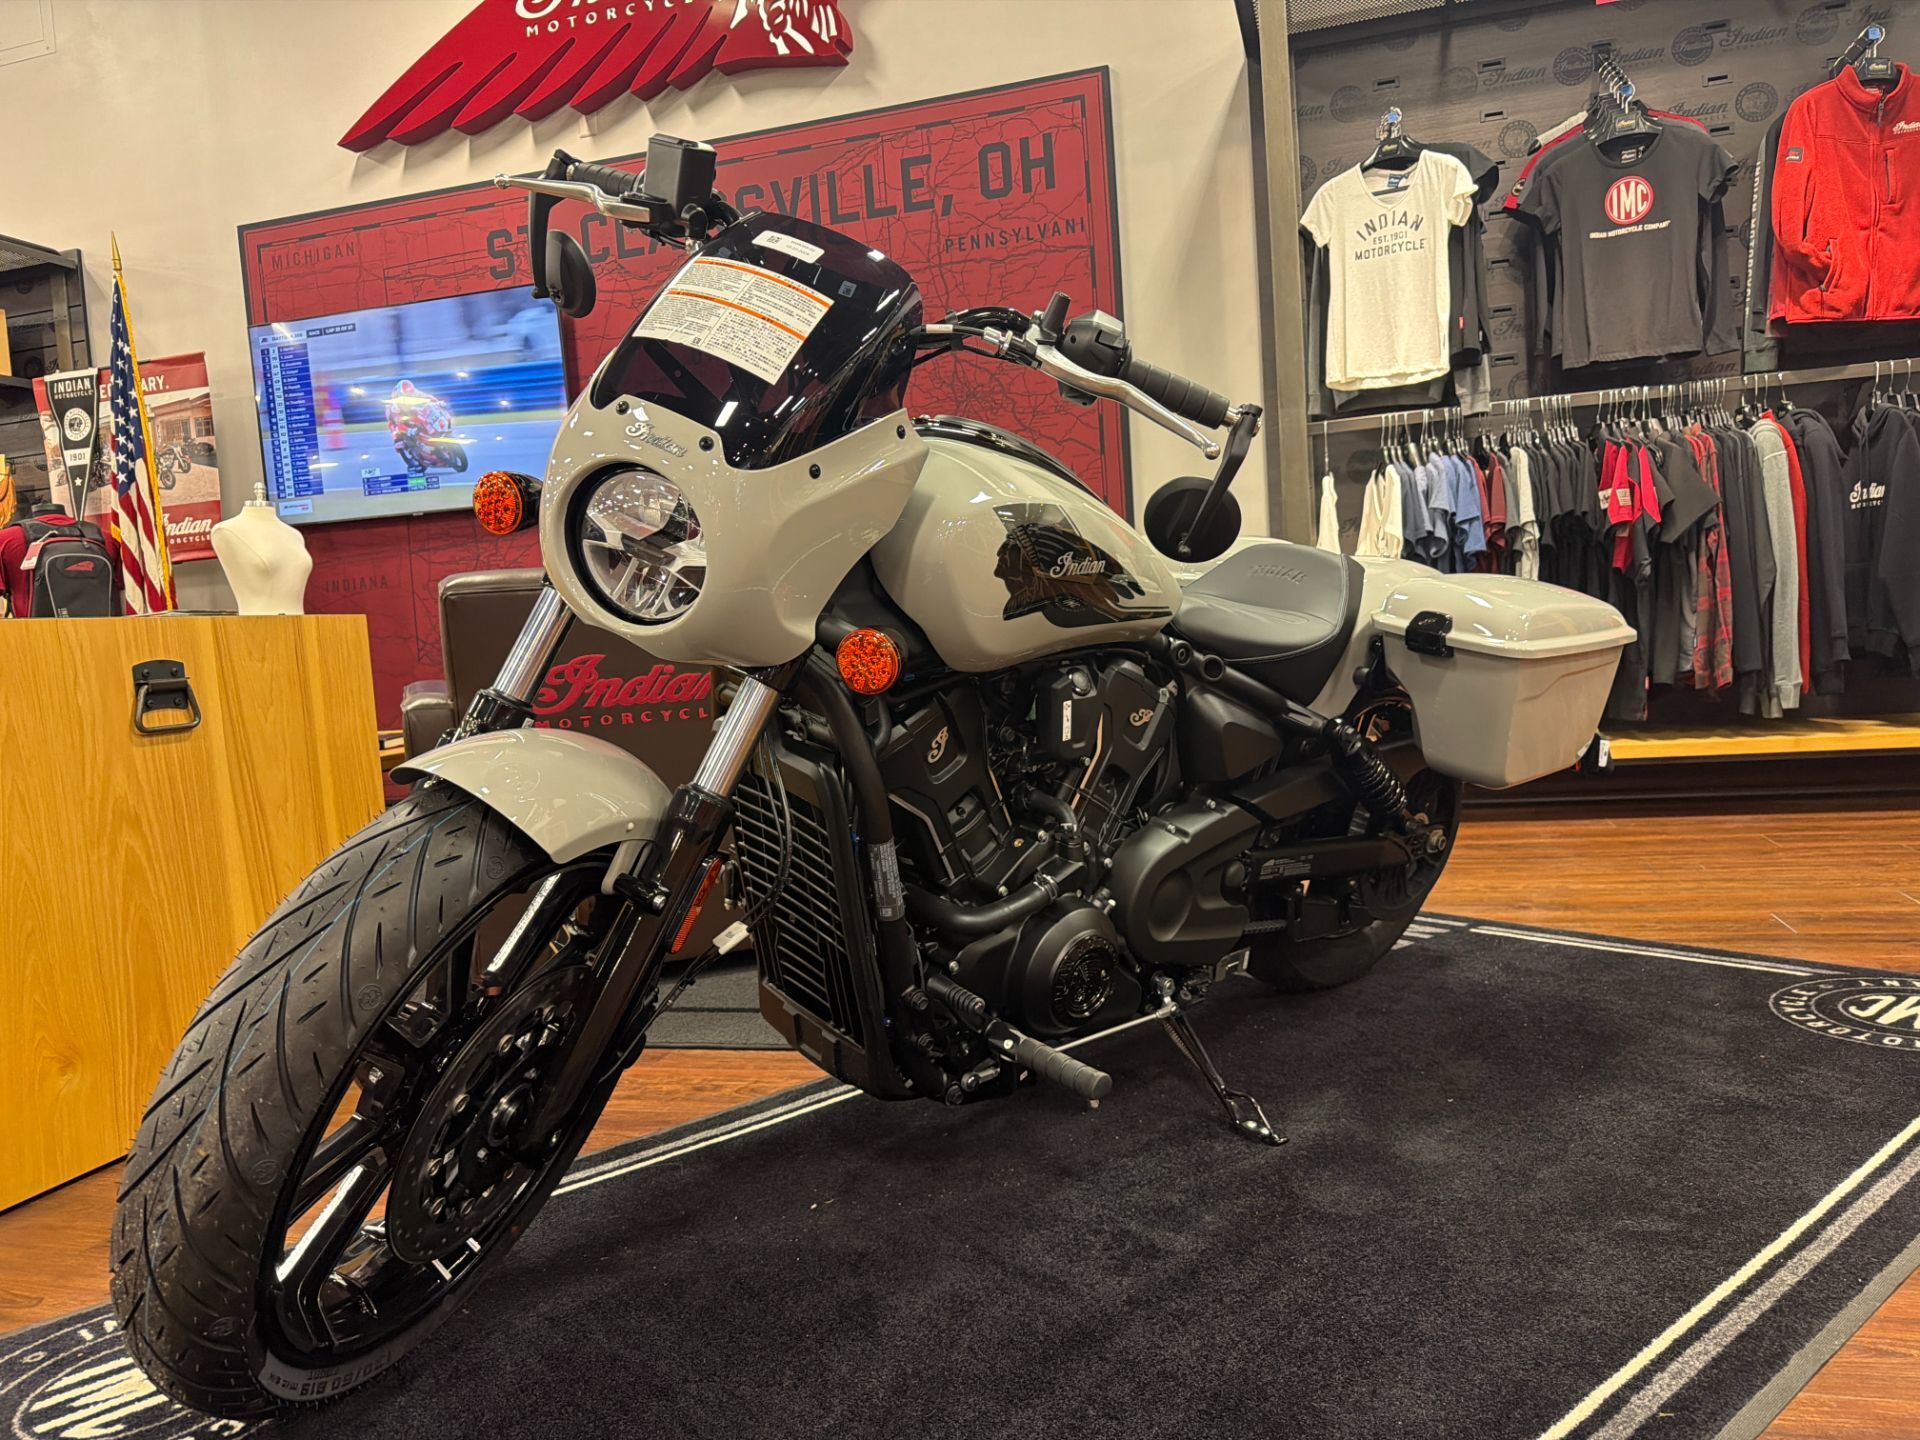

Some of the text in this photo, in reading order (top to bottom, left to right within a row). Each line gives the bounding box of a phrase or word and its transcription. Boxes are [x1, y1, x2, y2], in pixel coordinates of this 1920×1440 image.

[977, 132, 1056, 200] OH
[1611, 180, 1648, 220] IMC
[1356, 210, 1424, 242] INDIAN
[271, 242, 357, 271] MICHIGAN
[1354, 238, 1426, 261] MOTORCYCLE
[54, 378, 91, 394] INDIAN
[70, 452, 86, 462] 1901
[1050, 551, 1106, 578] Indian
[326, 575, 389, 593] INDIANA
[534, 707, 709, 729] MOTORCYCL
